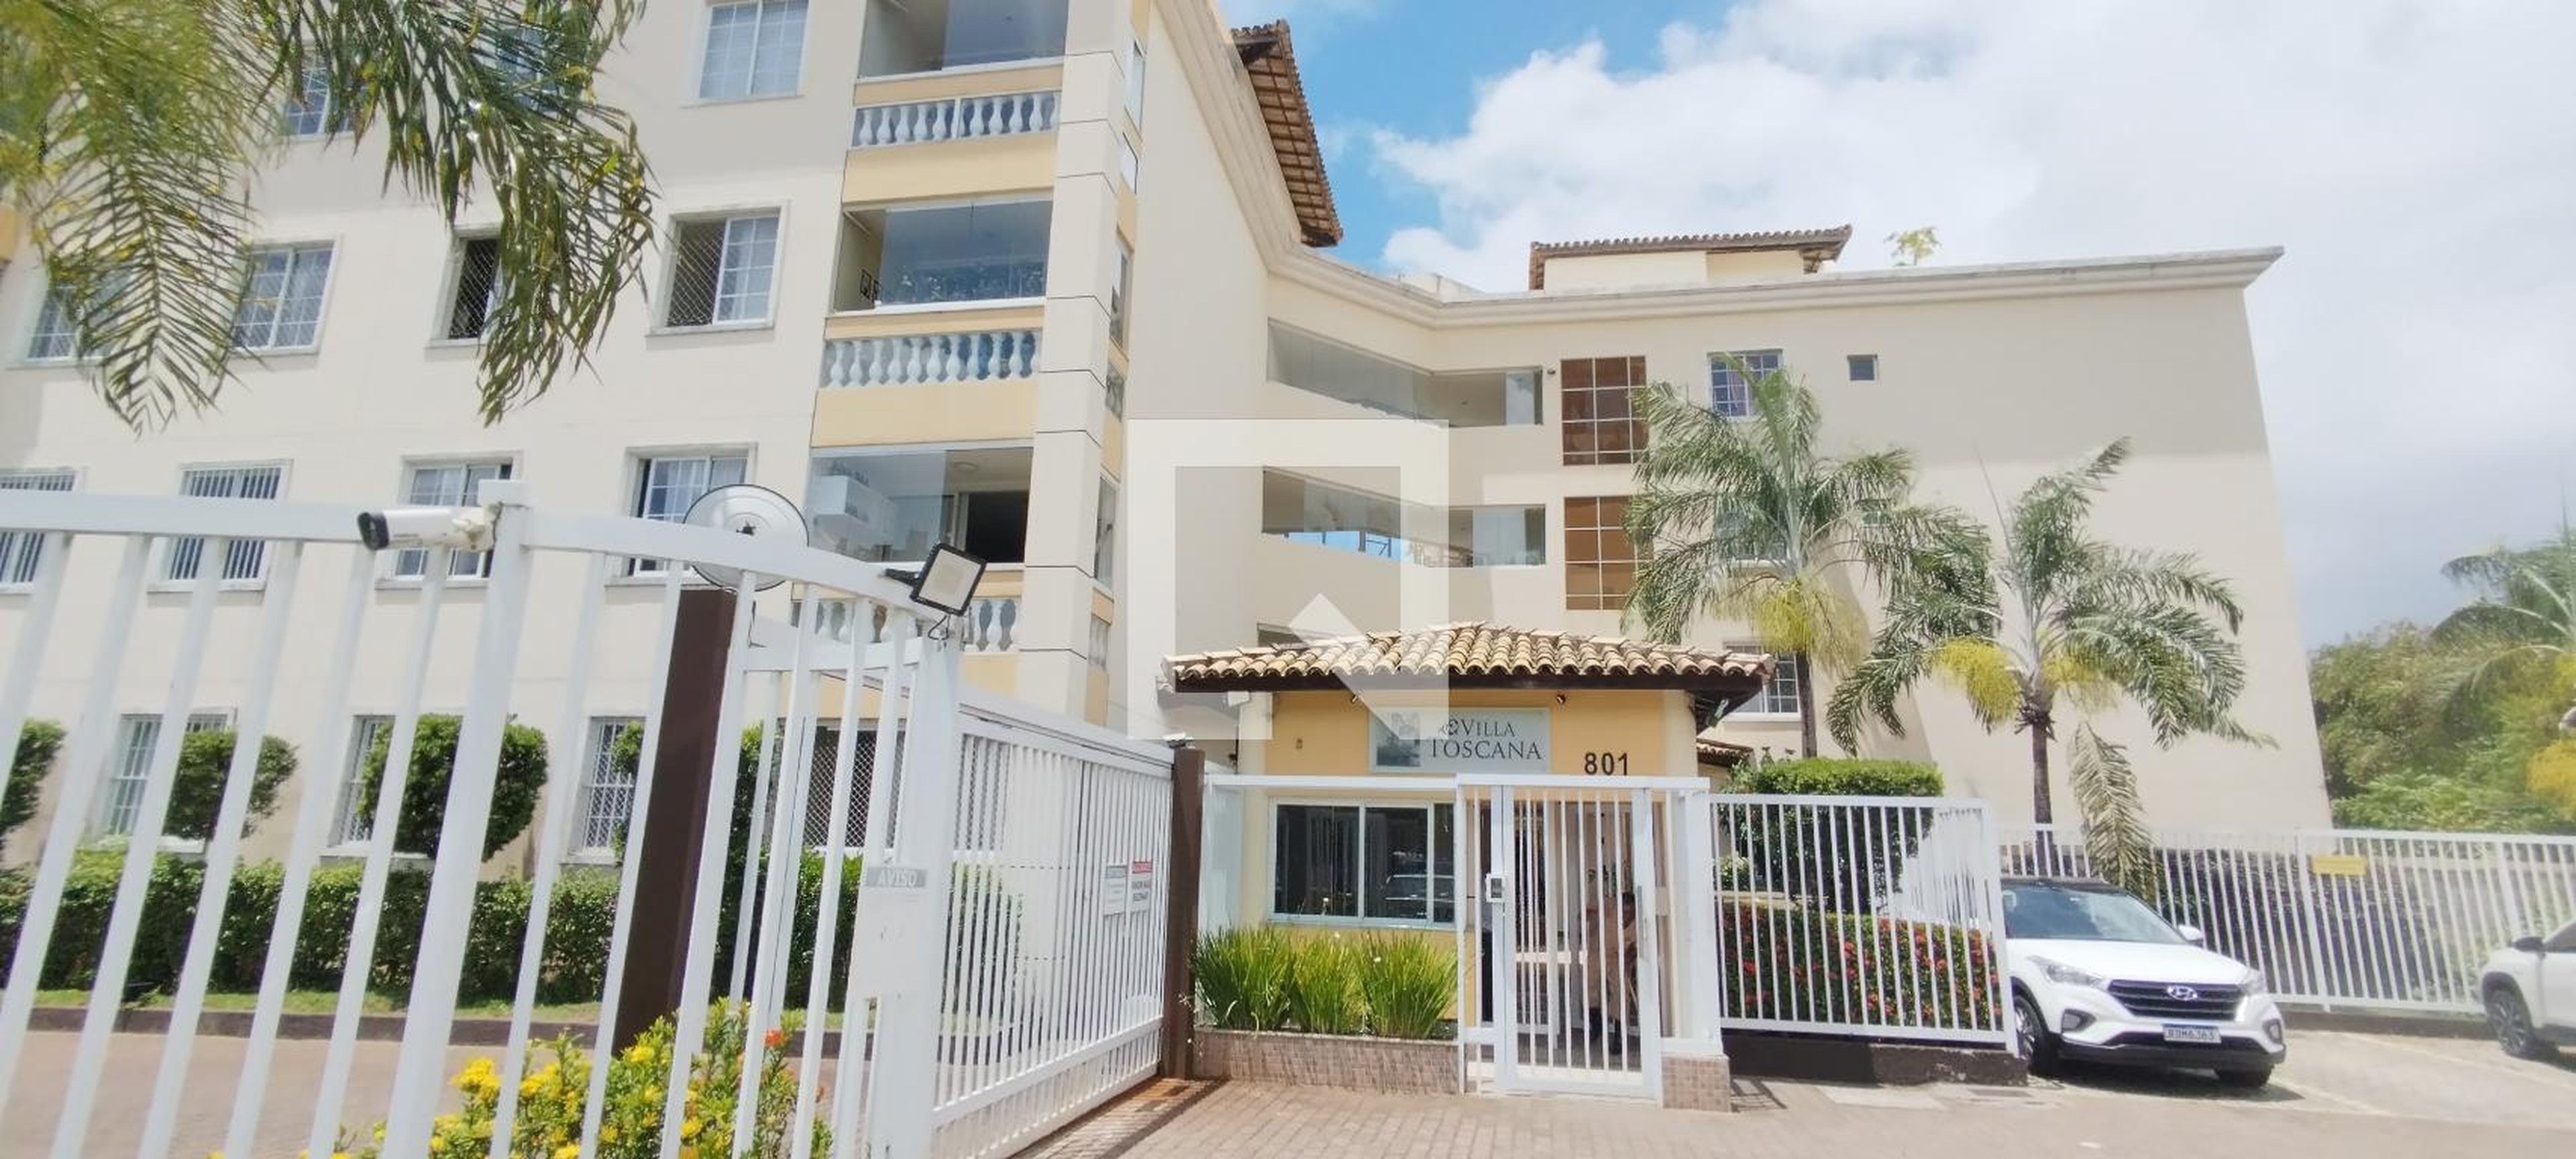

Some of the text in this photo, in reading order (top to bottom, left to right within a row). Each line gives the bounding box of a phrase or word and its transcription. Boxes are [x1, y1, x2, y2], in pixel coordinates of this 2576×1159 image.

[1430, 738, 1542, 760] TOSCANA
[1584, 752, 1628, 776] 801
[877, 869, 917, 887] AVISO
